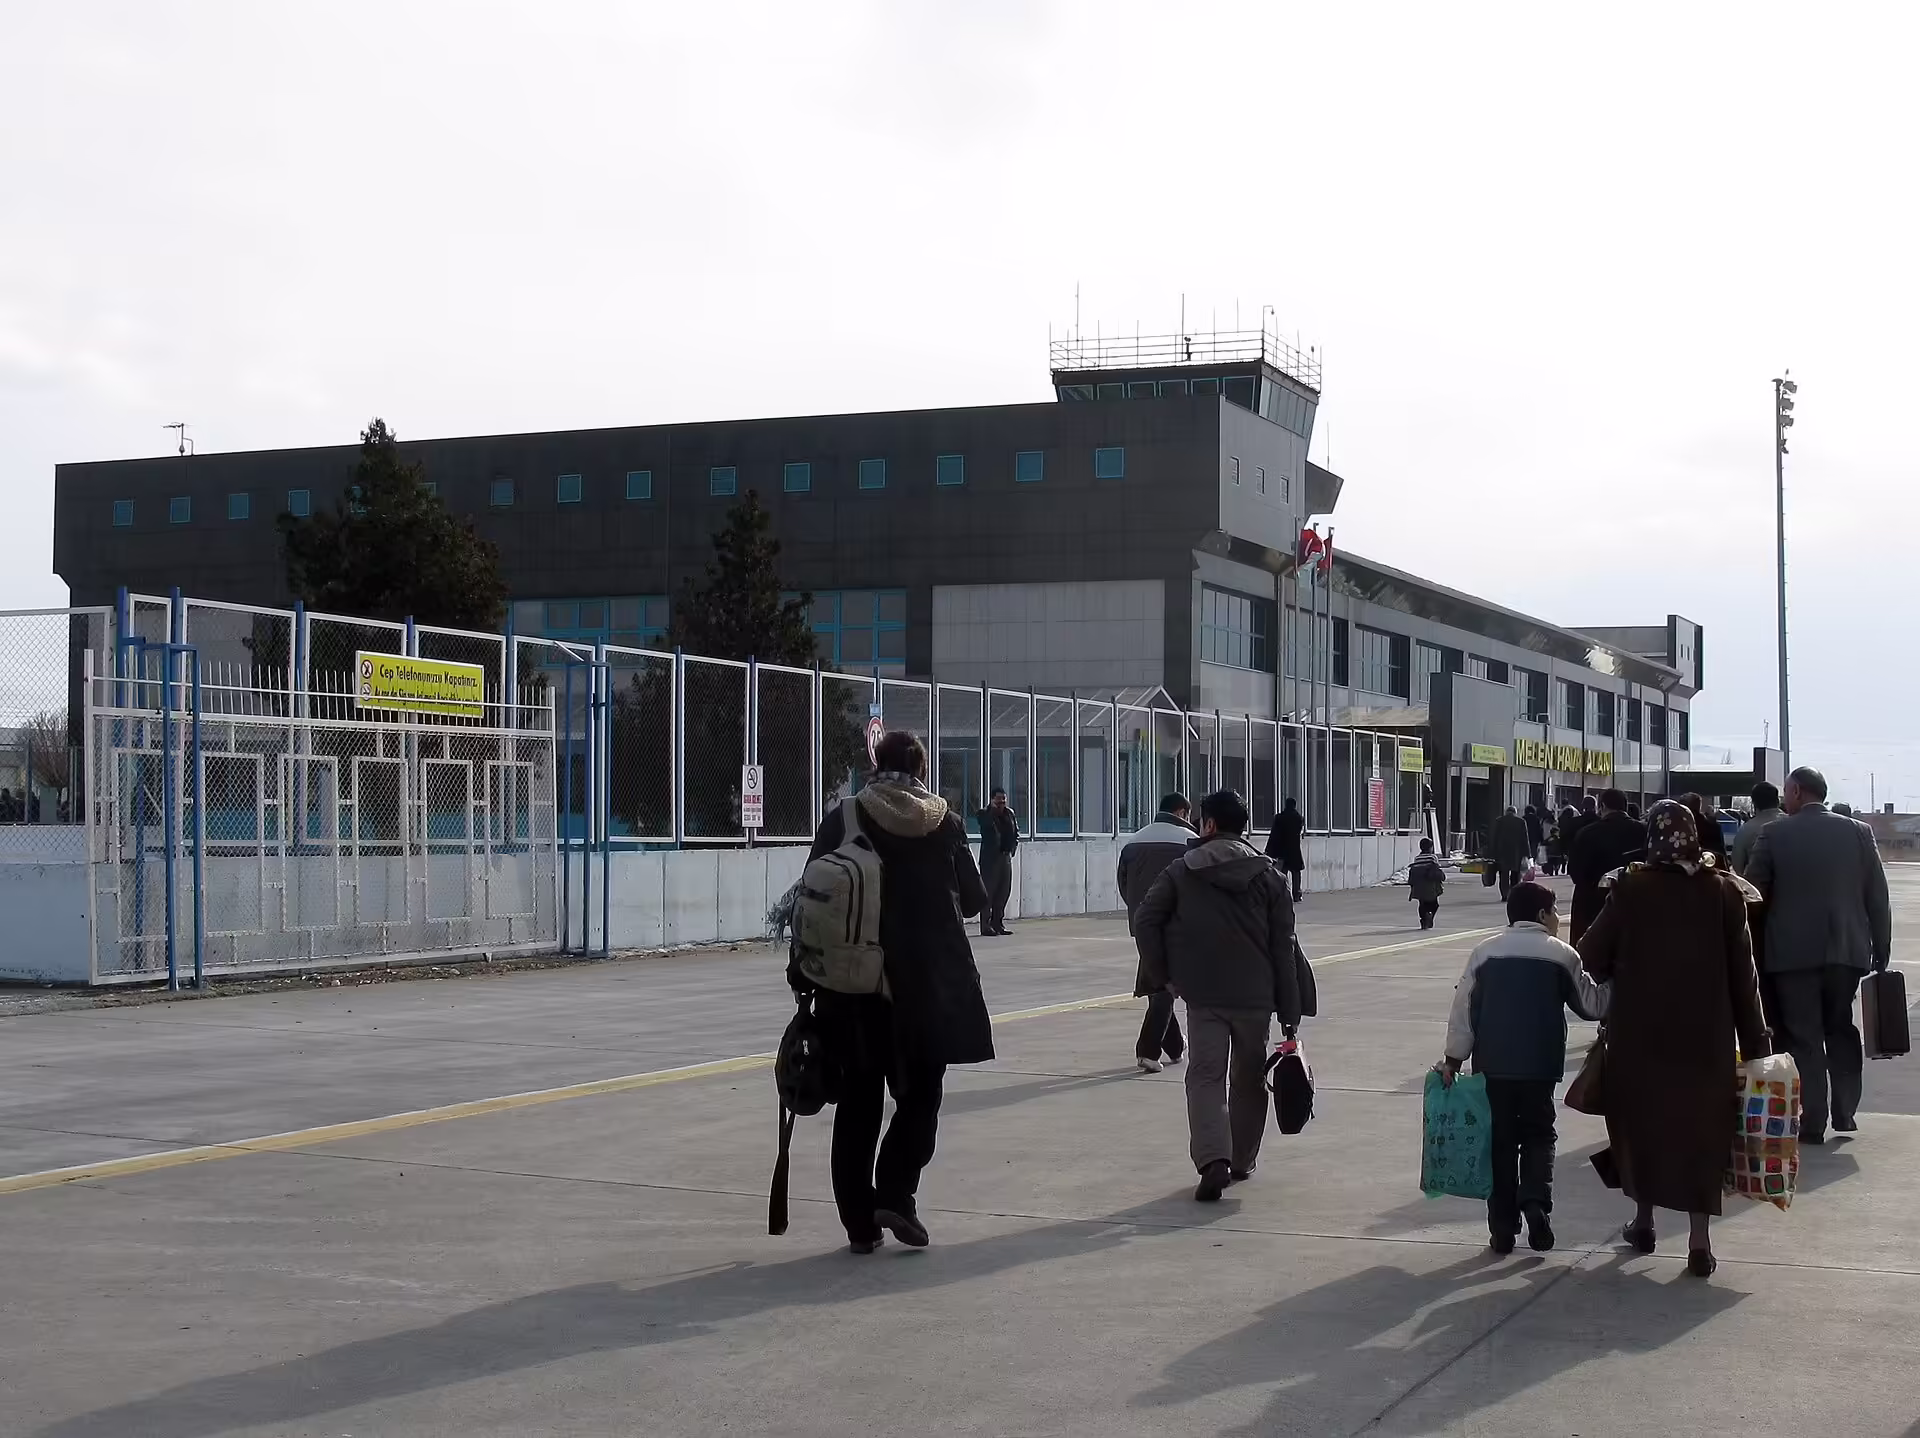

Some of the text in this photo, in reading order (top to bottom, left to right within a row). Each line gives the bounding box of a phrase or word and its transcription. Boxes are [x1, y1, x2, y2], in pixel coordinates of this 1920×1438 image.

[379, 664, 394, 682] Cep
[396, 665, 442, 684] Telefonunuzu
[1514, 739, 1553, 769] MELEN
[1555, 746, 1582, 772] HAVA
